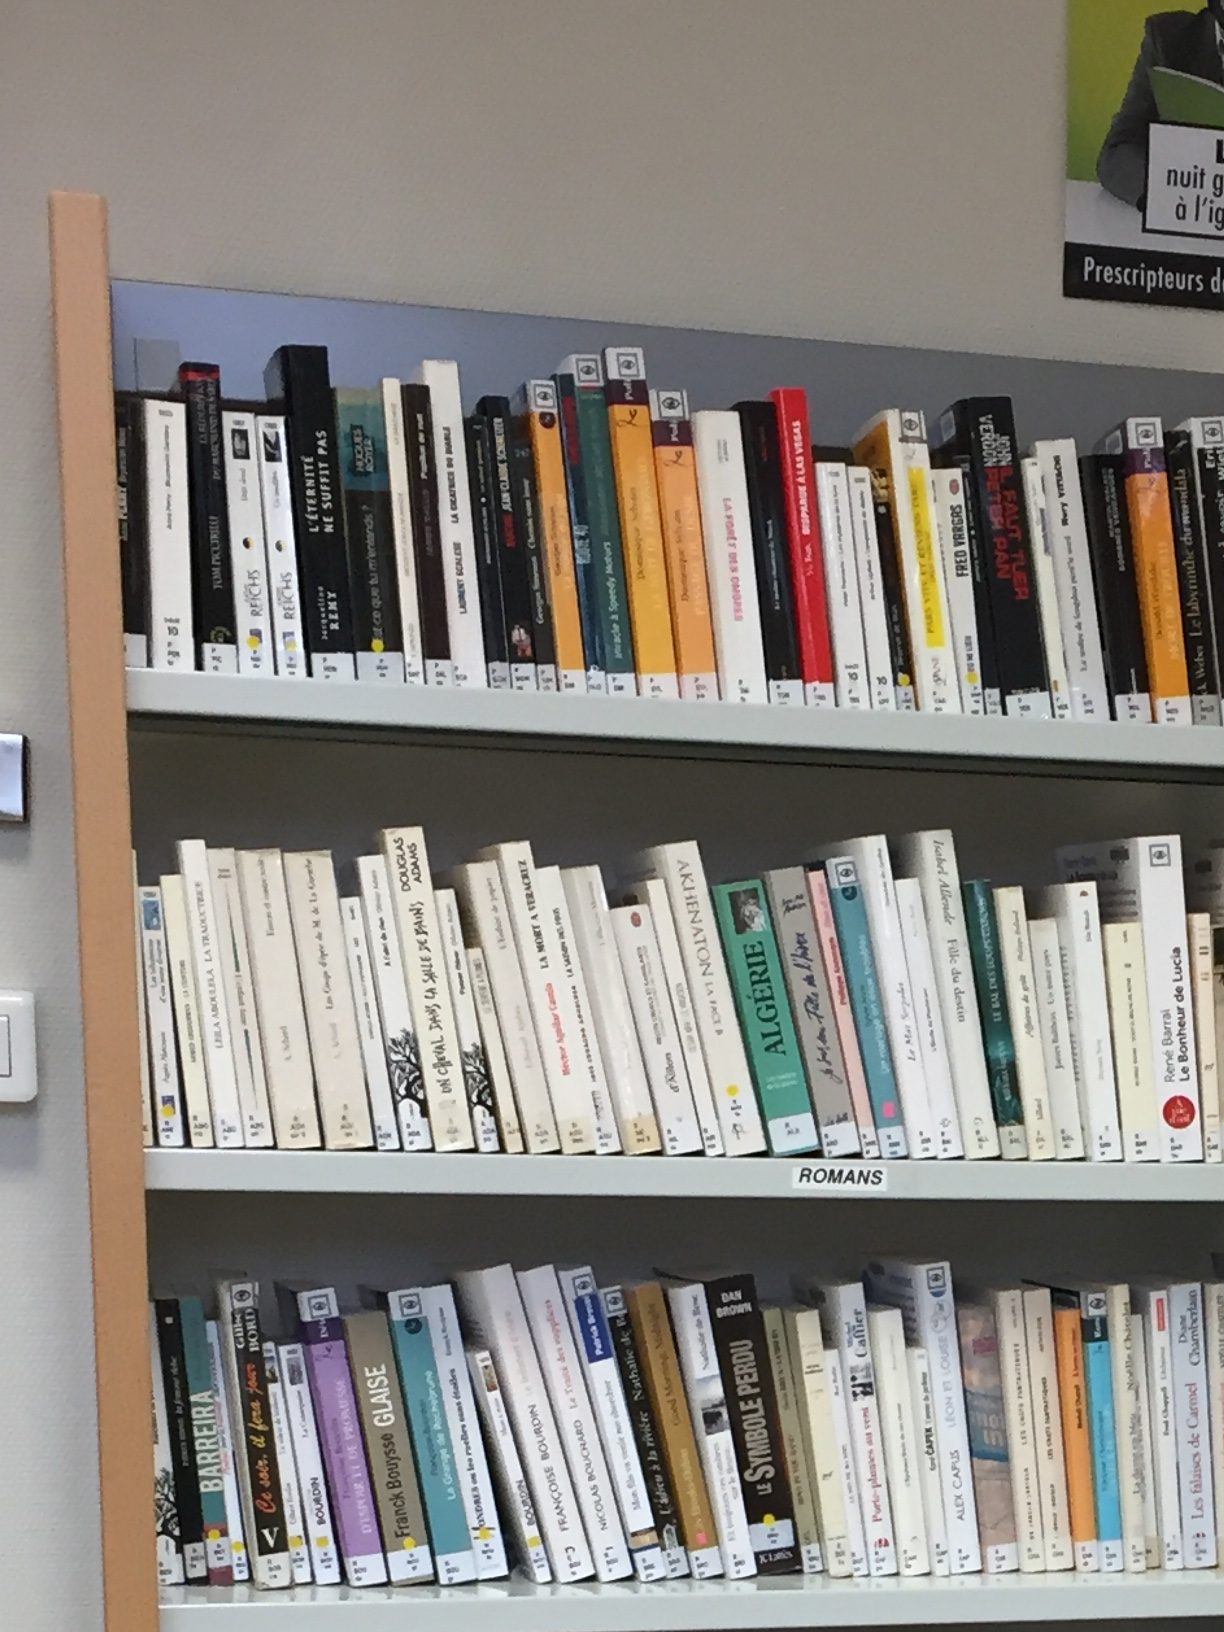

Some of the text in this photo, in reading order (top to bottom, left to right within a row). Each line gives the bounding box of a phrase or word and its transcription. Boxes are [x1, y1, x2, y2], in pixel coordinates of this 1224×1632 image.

[1166, 164, 1207, 190] nuit
[1174, 195, 1187, 222] à
[1083, 255, 1206, 294] Prescripteurs
[352, 428, 364, 472] HUGUES
[362, 437, 374, 473] ROYER
[792, 421, 804, 453] VEGAS
[979, 414, 996, 467] VERDON
[998, 435, 1011, 466] JOHN
[315, 430, 334, 532] NE SUFFIT PAS
[795, 456, 806, 474] LAS
[301, 455, 319, 532] L'ÉTERNITÉ
[450, 514, 459, 524] LA
[950, 504, 969, 578] FRED VARGAS
[1176, 468, 1204, 637] Le labyrinthe du mandala
[248, 569, 263, 617] REICHS
[280, 572, 296, 619] REICHS
[326, 591, 339, 630] REMY
[455, 579, 468, 614] LAURENT
[606, 577, 621, 612] Speedy
[394, 836, 411, 892] DOUGLAS
[407, 843, 422, 884] ADAMS
[517, 859, 538, 911] VERACRUZ
[676, 859, 714, 976] AKHENATON
[938, 878, 954, 925] Allende
[531, 924, 548, 953] MORT
[947, 939, 960, 962] Fille
[194, 881, 224, 1049] LEILA ABOULELA LA TRADUCTRICE
[538, 956, 550, 969] LA
[951, 965, 962, 978] du
[409, 901, 453, 1075] CHEVAL DANS SALLE DE BAINS
[742, 940, 788, 1057] ALGÉRIE
[953, 981, 966, 1022] destin
[1170, 947, 1191, 1081] Le Bonheur de Lucia
[1160, 1009, 1176, 1082] René Barral
[799, 1168, 884, 1185] ROMANS
[589, 1324, 605, 1356] Patrick
[1178, 1314, 1188, 1344] Diane
[1186, 1289, 1201, 1366] Chamberlain
[1124, 1353, 1135, 1391] Noëlle
[625, 1349, 661, 1461] la rivière Nathalie
[728, 1339, 777, 1495] LE SYMBOLE PERDU
[189, 1390, 223, 1492] BARREIRA
[245, 1362, 277, 1514] Ce il fera jour
[364, 1364, 411, 1538] Franck Bouysse GLAISE
[1185, 1382, 1204, 1519] Les falaises de Carmel
[436, 1433, 456, 1499] La Grange de
[466, 1458, 476, 1471] les
[528, 1404, 569, 1532] FRANÇOISE BOURDIN
[949, 1450, 965, 1521] ALEX CAPUS
[309, 1476, 325, 1526] BOURDIN
[516, 1479, 536, 1526] BOURDIN
[589, 1484, 609, 1531] NICOLAS
